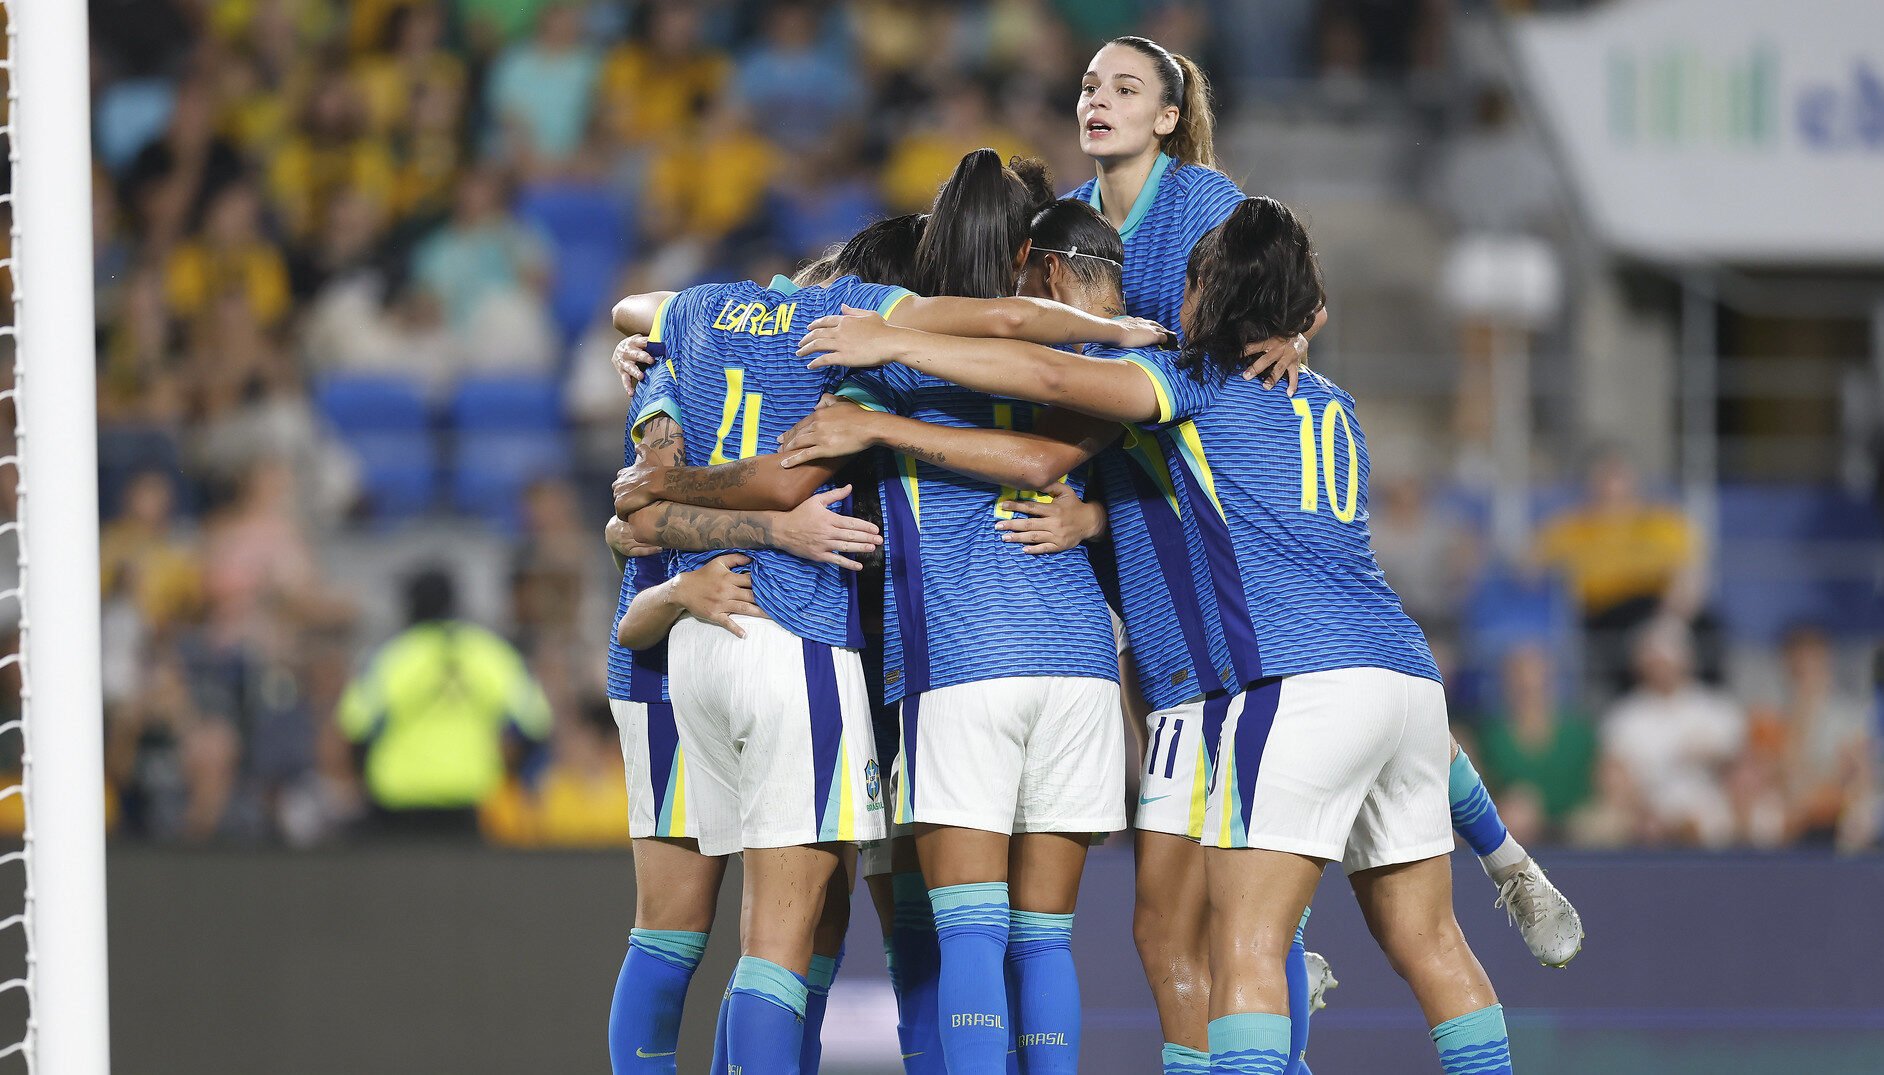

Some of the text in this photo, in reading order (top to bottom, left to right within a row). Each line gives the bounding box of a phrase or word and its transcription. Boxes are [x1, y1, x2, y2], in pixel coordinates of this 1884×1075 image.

[708, 367, 763, 466] 4
[1290, 398, 1358, 523] 10
[1148, 716, 1184, 780] 11
[951, 1012, 1005, 1030] BRASIL
[1018, 1032, 1068, 1048] BRASIL
